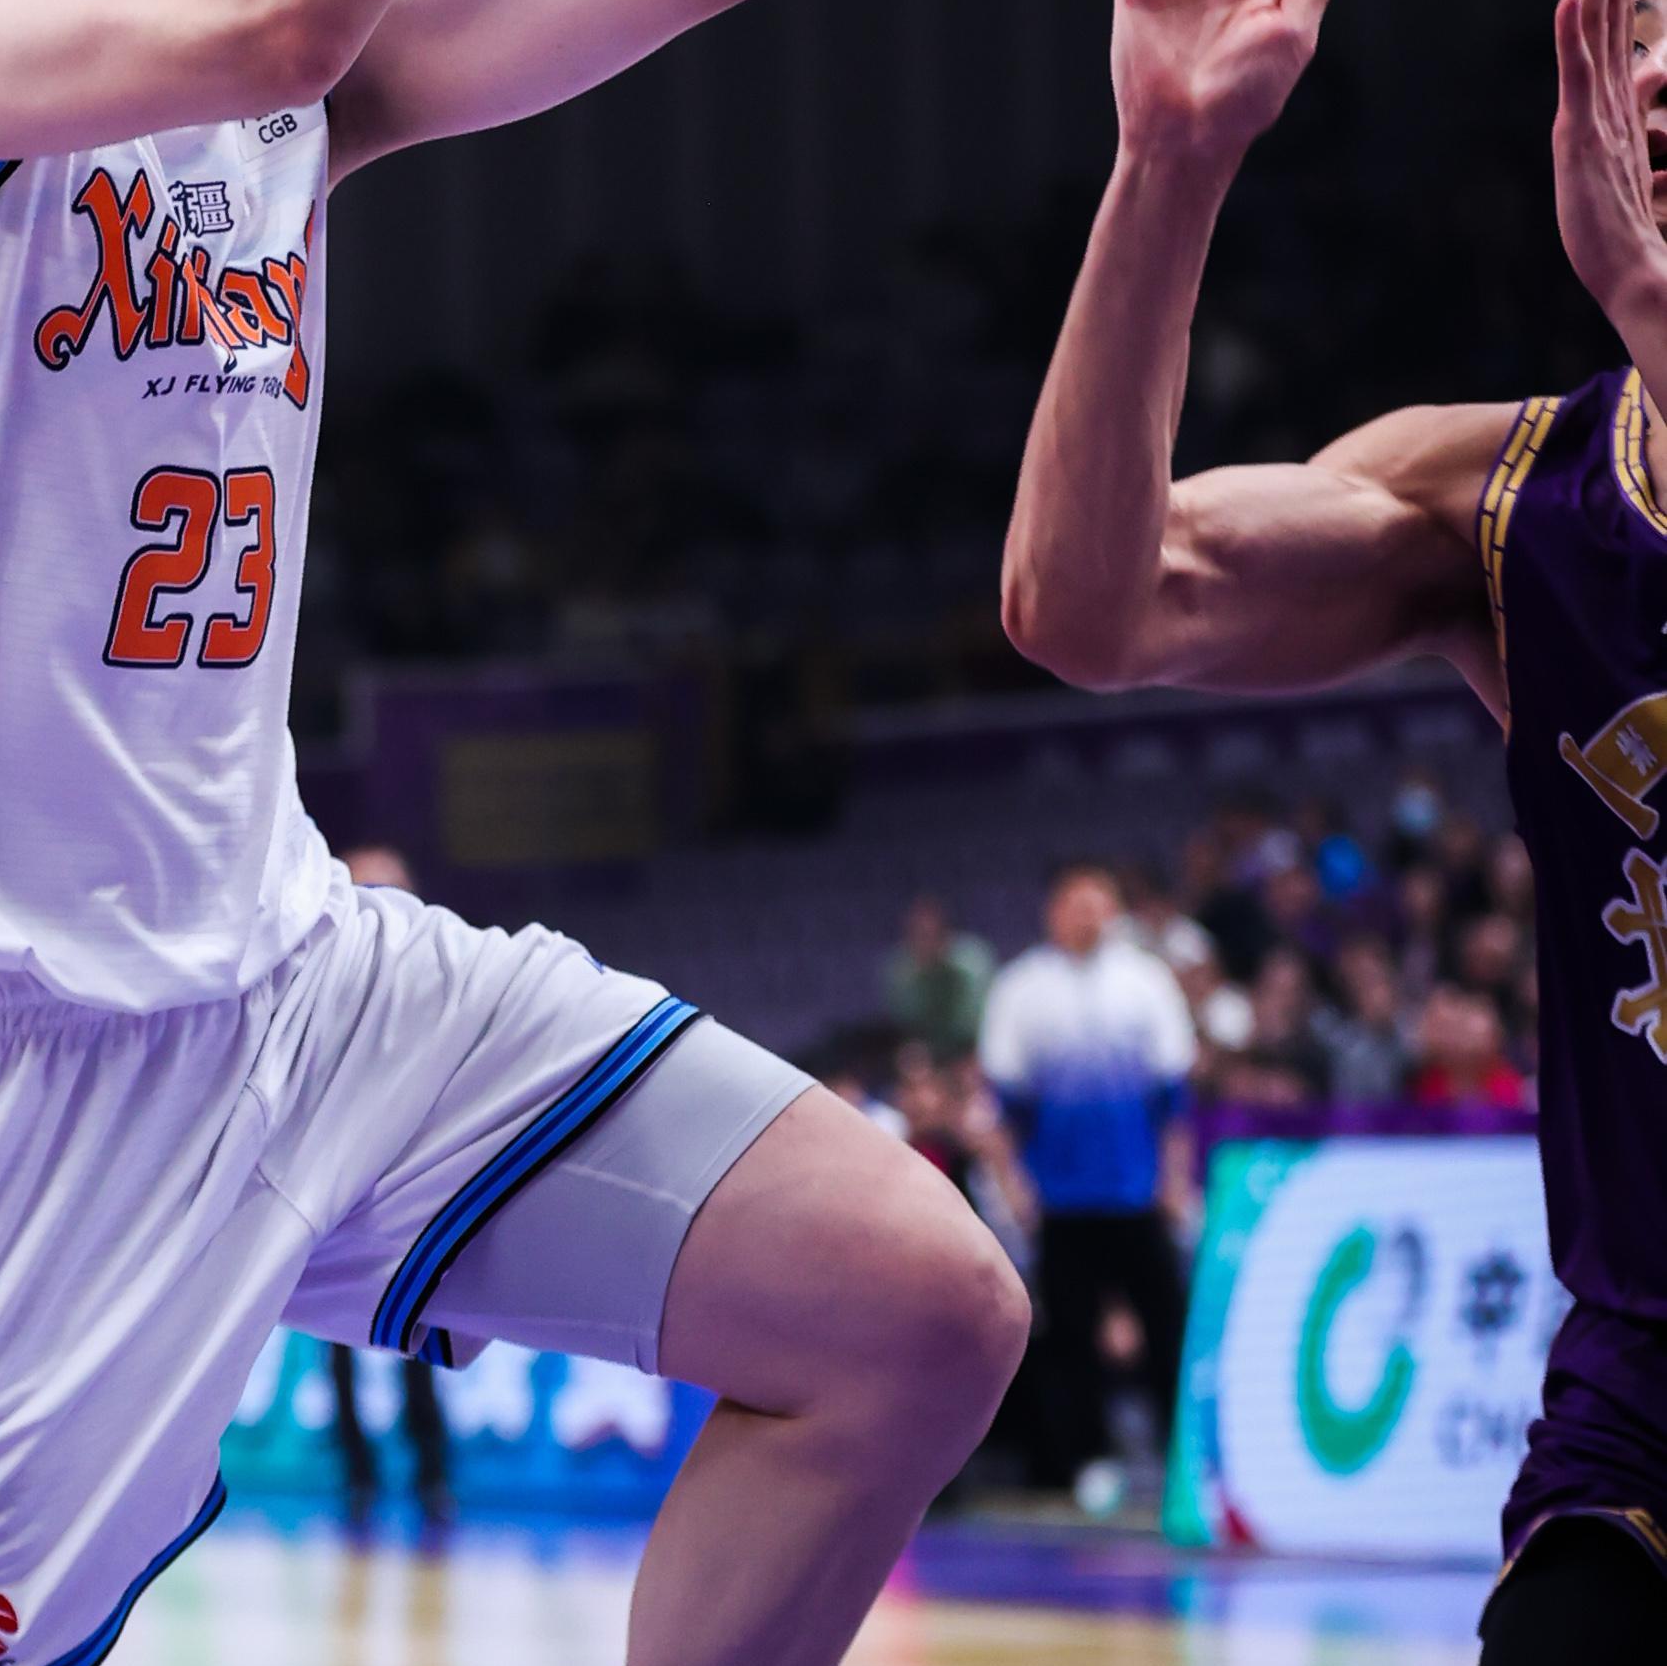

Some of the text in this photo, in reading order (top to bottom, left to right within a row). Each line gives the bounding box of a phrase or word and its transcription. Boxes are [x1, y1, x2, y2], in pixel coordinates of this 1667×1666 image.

[258, 113, 298, 144] CGB
[142, 376, 176, 400] XJ
[184, 374, 256, 394] FLYING
[102, 465, 276, 668] 23
